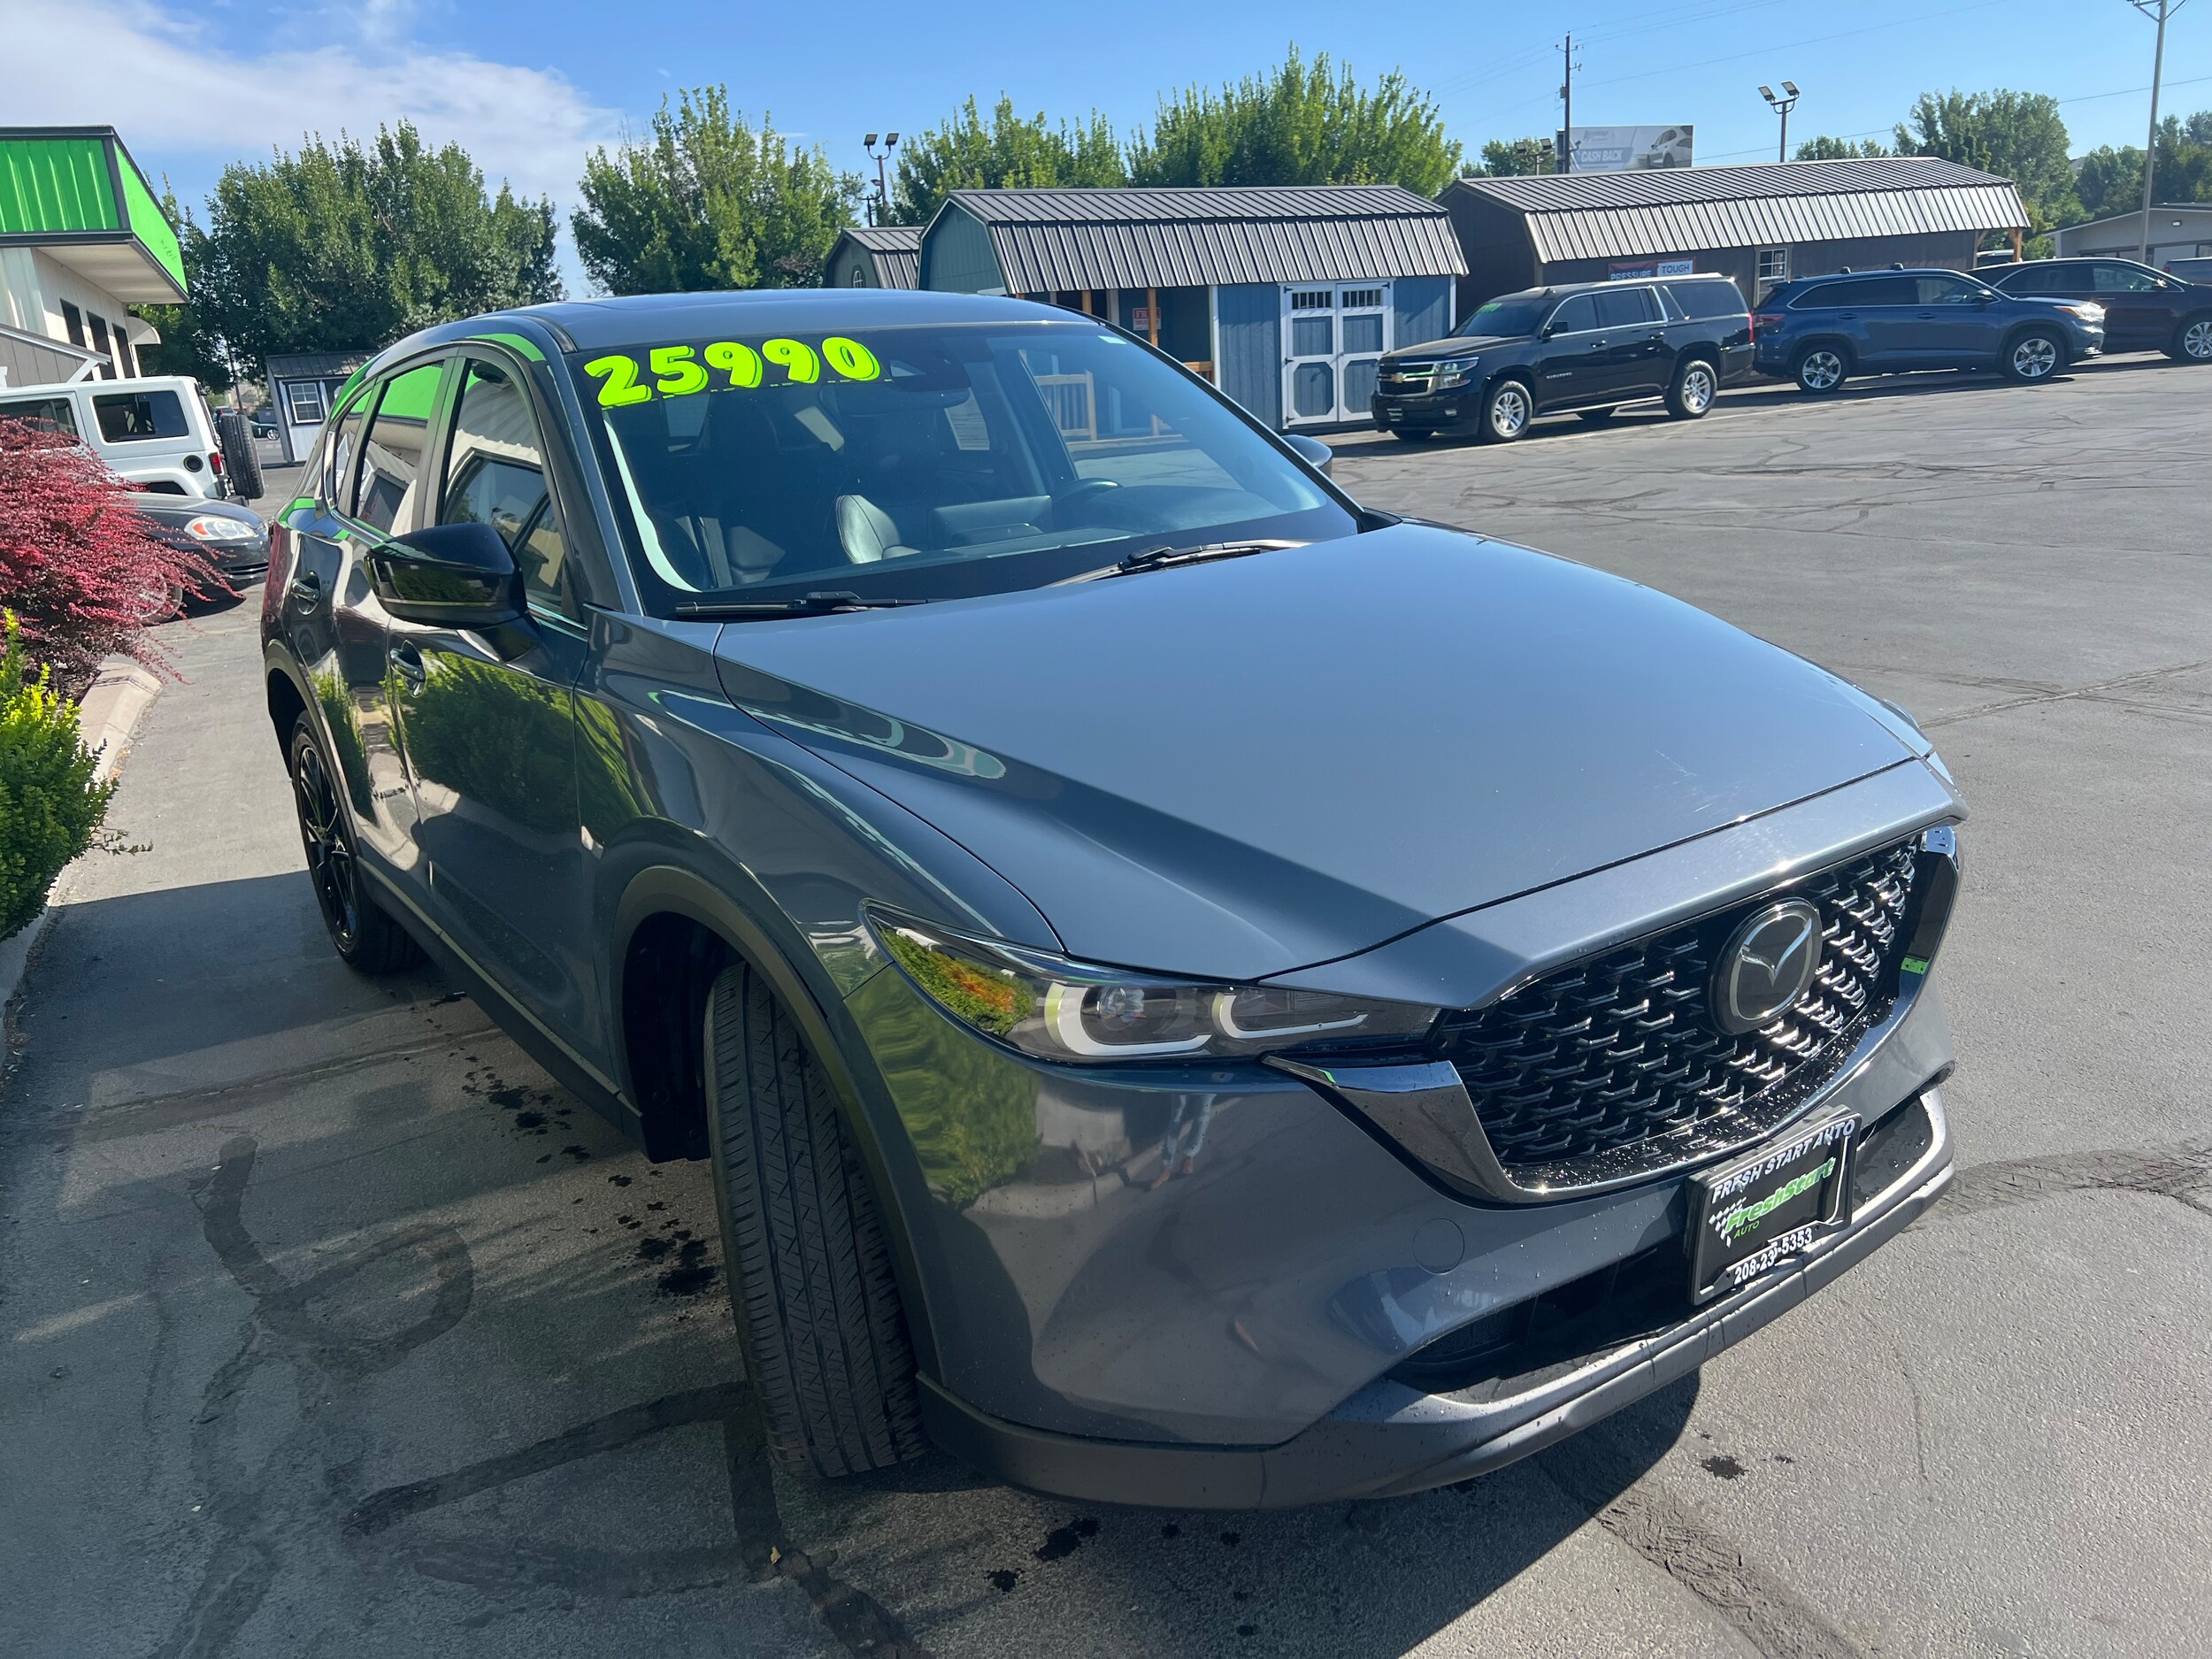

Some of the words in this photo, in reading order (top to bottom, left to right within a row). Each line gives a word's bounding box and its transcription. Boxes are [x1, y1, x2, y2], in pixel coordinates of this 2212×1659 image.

[1610, 270, 1652, 281] PRESSURE
[1661, 264, 1690, 274] TOUGH
[584, 336, 881, 407] 25990
[1711, 1164, 1763, 1204] FRESH
[1764, 1138, 1813, 1175] START
[1812, 1118, 1855, 1150] AUTO
[1733, 1220, 1760, 1240] AUTO
